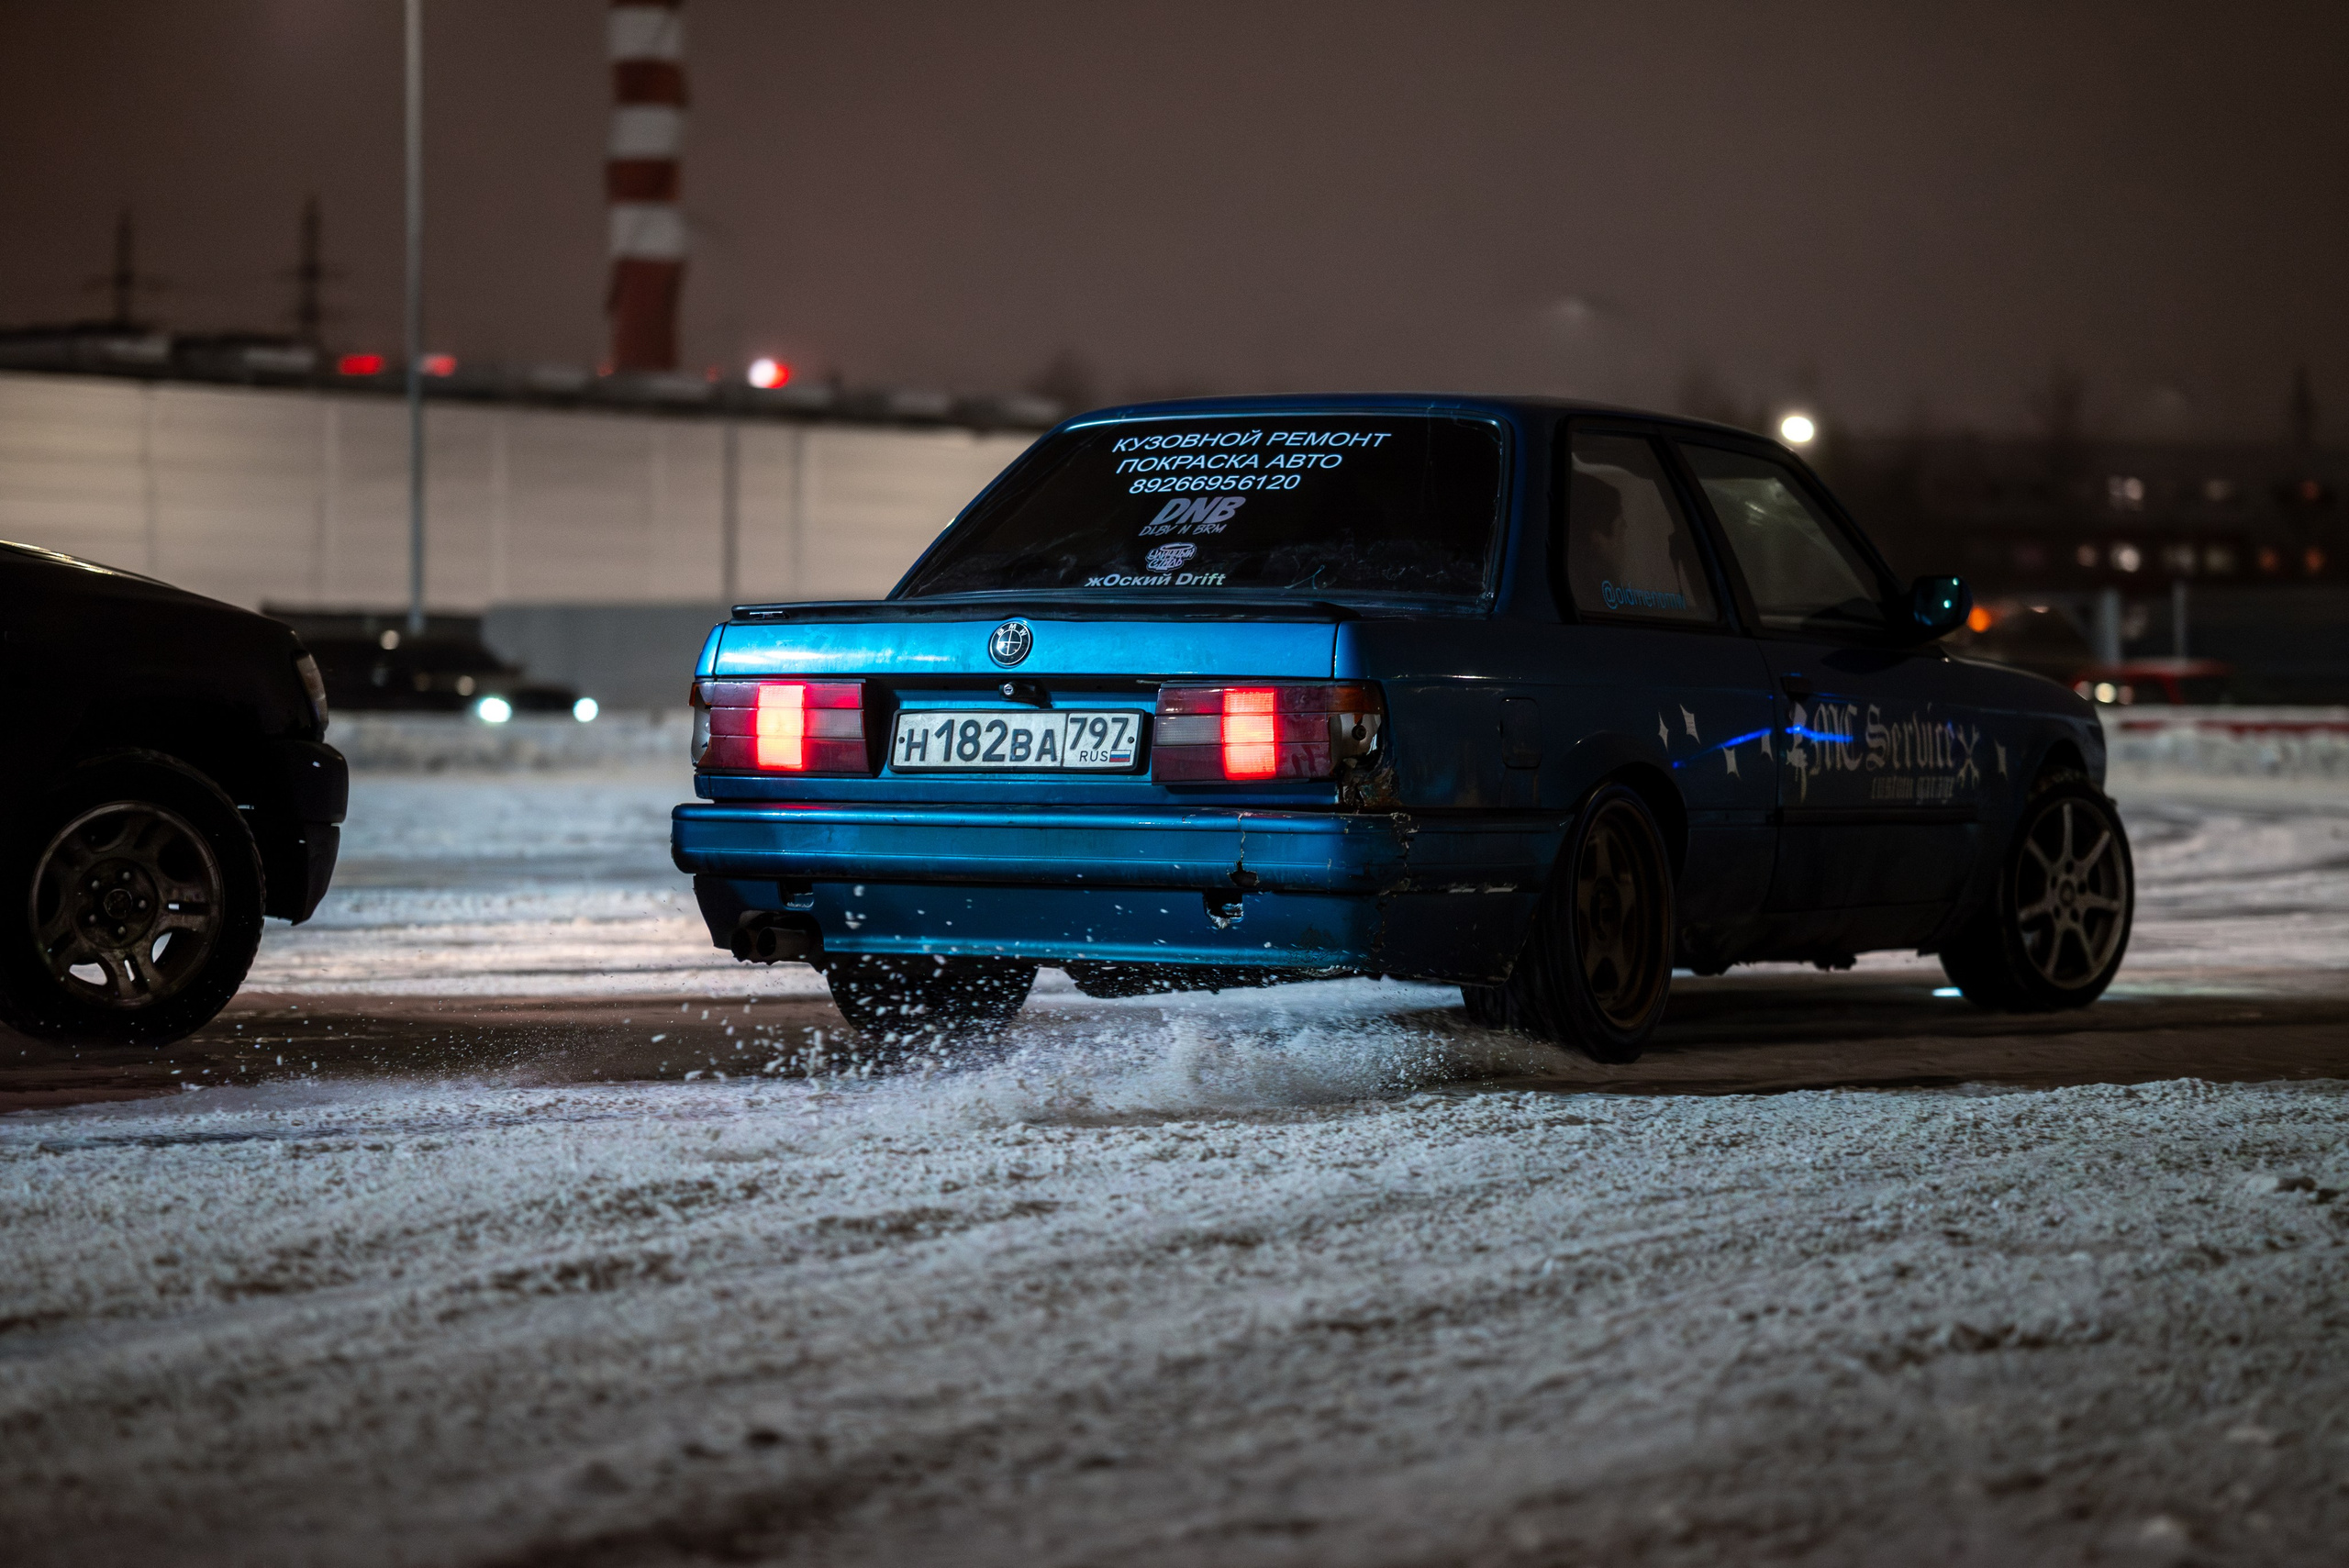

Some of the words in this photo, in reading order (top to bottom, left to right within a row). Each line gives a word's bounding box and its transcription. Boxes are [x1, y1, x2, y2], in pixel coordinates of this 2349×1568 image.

[1111, 429, 1264, 452] КУЗОВНОЙ
[1265, 432, 1392, 448] РЕМОНТ
[1115, 453, 1260, 474] ПОКРАСКА
[1264, 453, 1343, 470] АВТО
[1128, 474, 1302, 495] 89266956120
[1148, 495, 1247, 526] DNB
[1174, 572, 1227, 586] Drift
[996, 623, 1028, 637] BMW
[1069, 717, 1129, 751] 797
[1079, 751, 1108, 762] RUS
